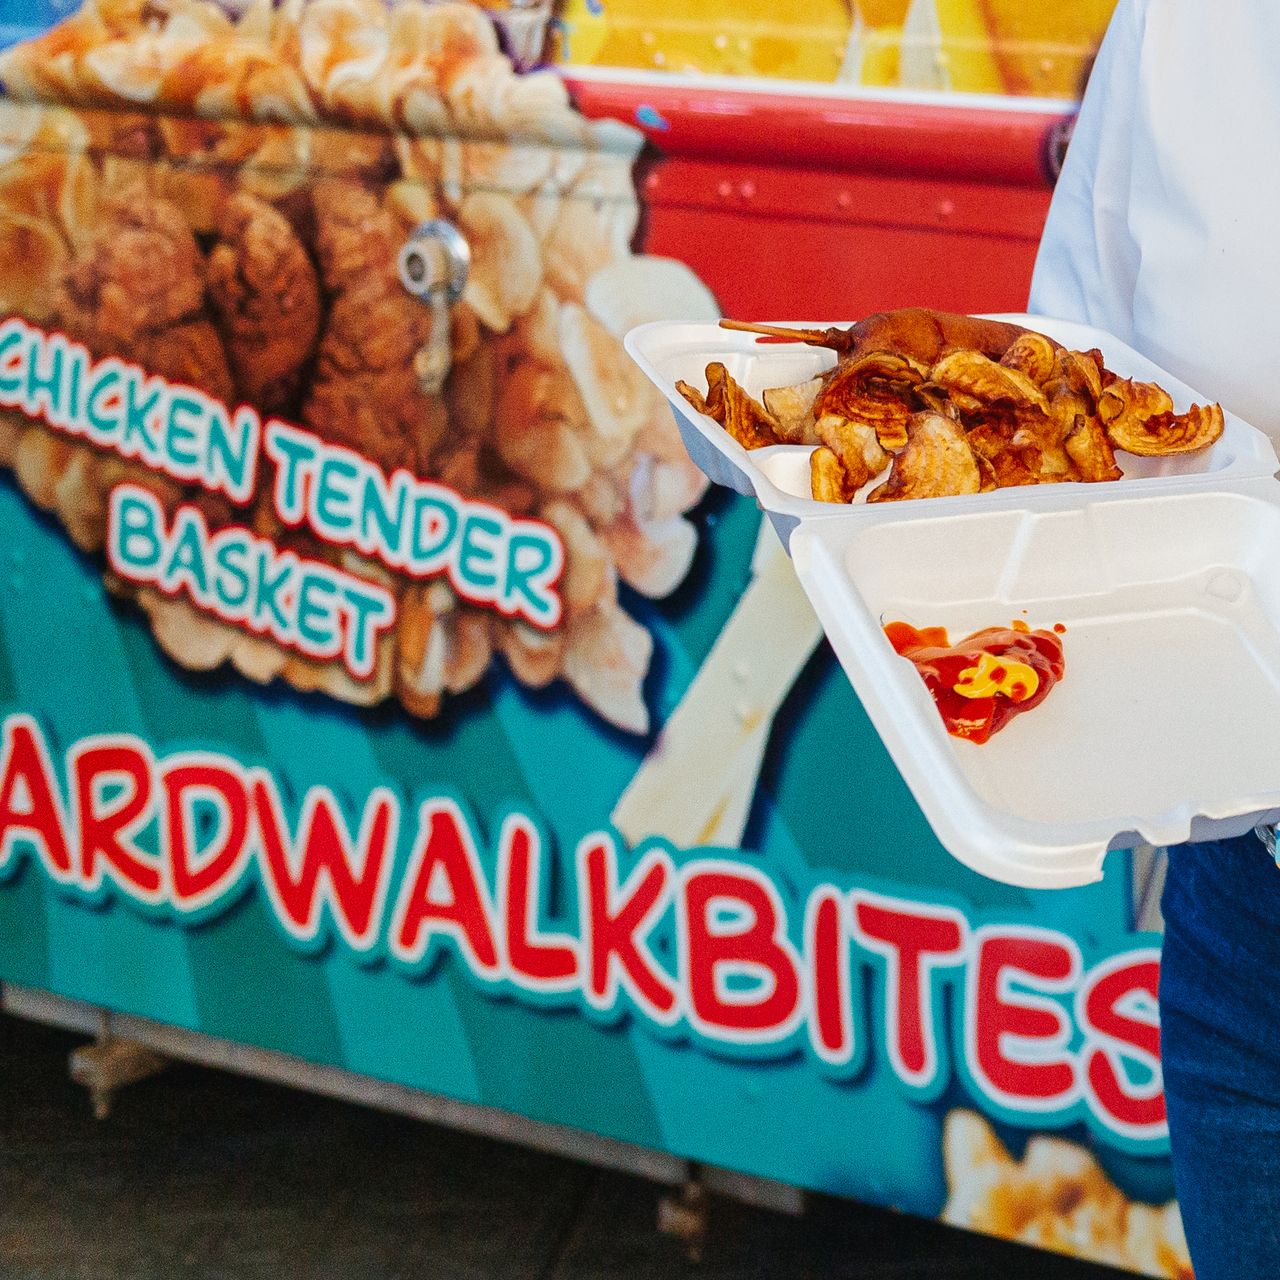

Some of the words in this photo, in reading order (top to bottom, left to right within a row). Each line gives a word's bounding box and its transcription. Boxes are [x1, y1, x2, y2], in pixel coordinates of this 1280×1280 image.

[0, 328, 260, 500] CHICKEN
[265, 426, 563, 626] TENDER
[114, 489, 392, 675] BASKET
